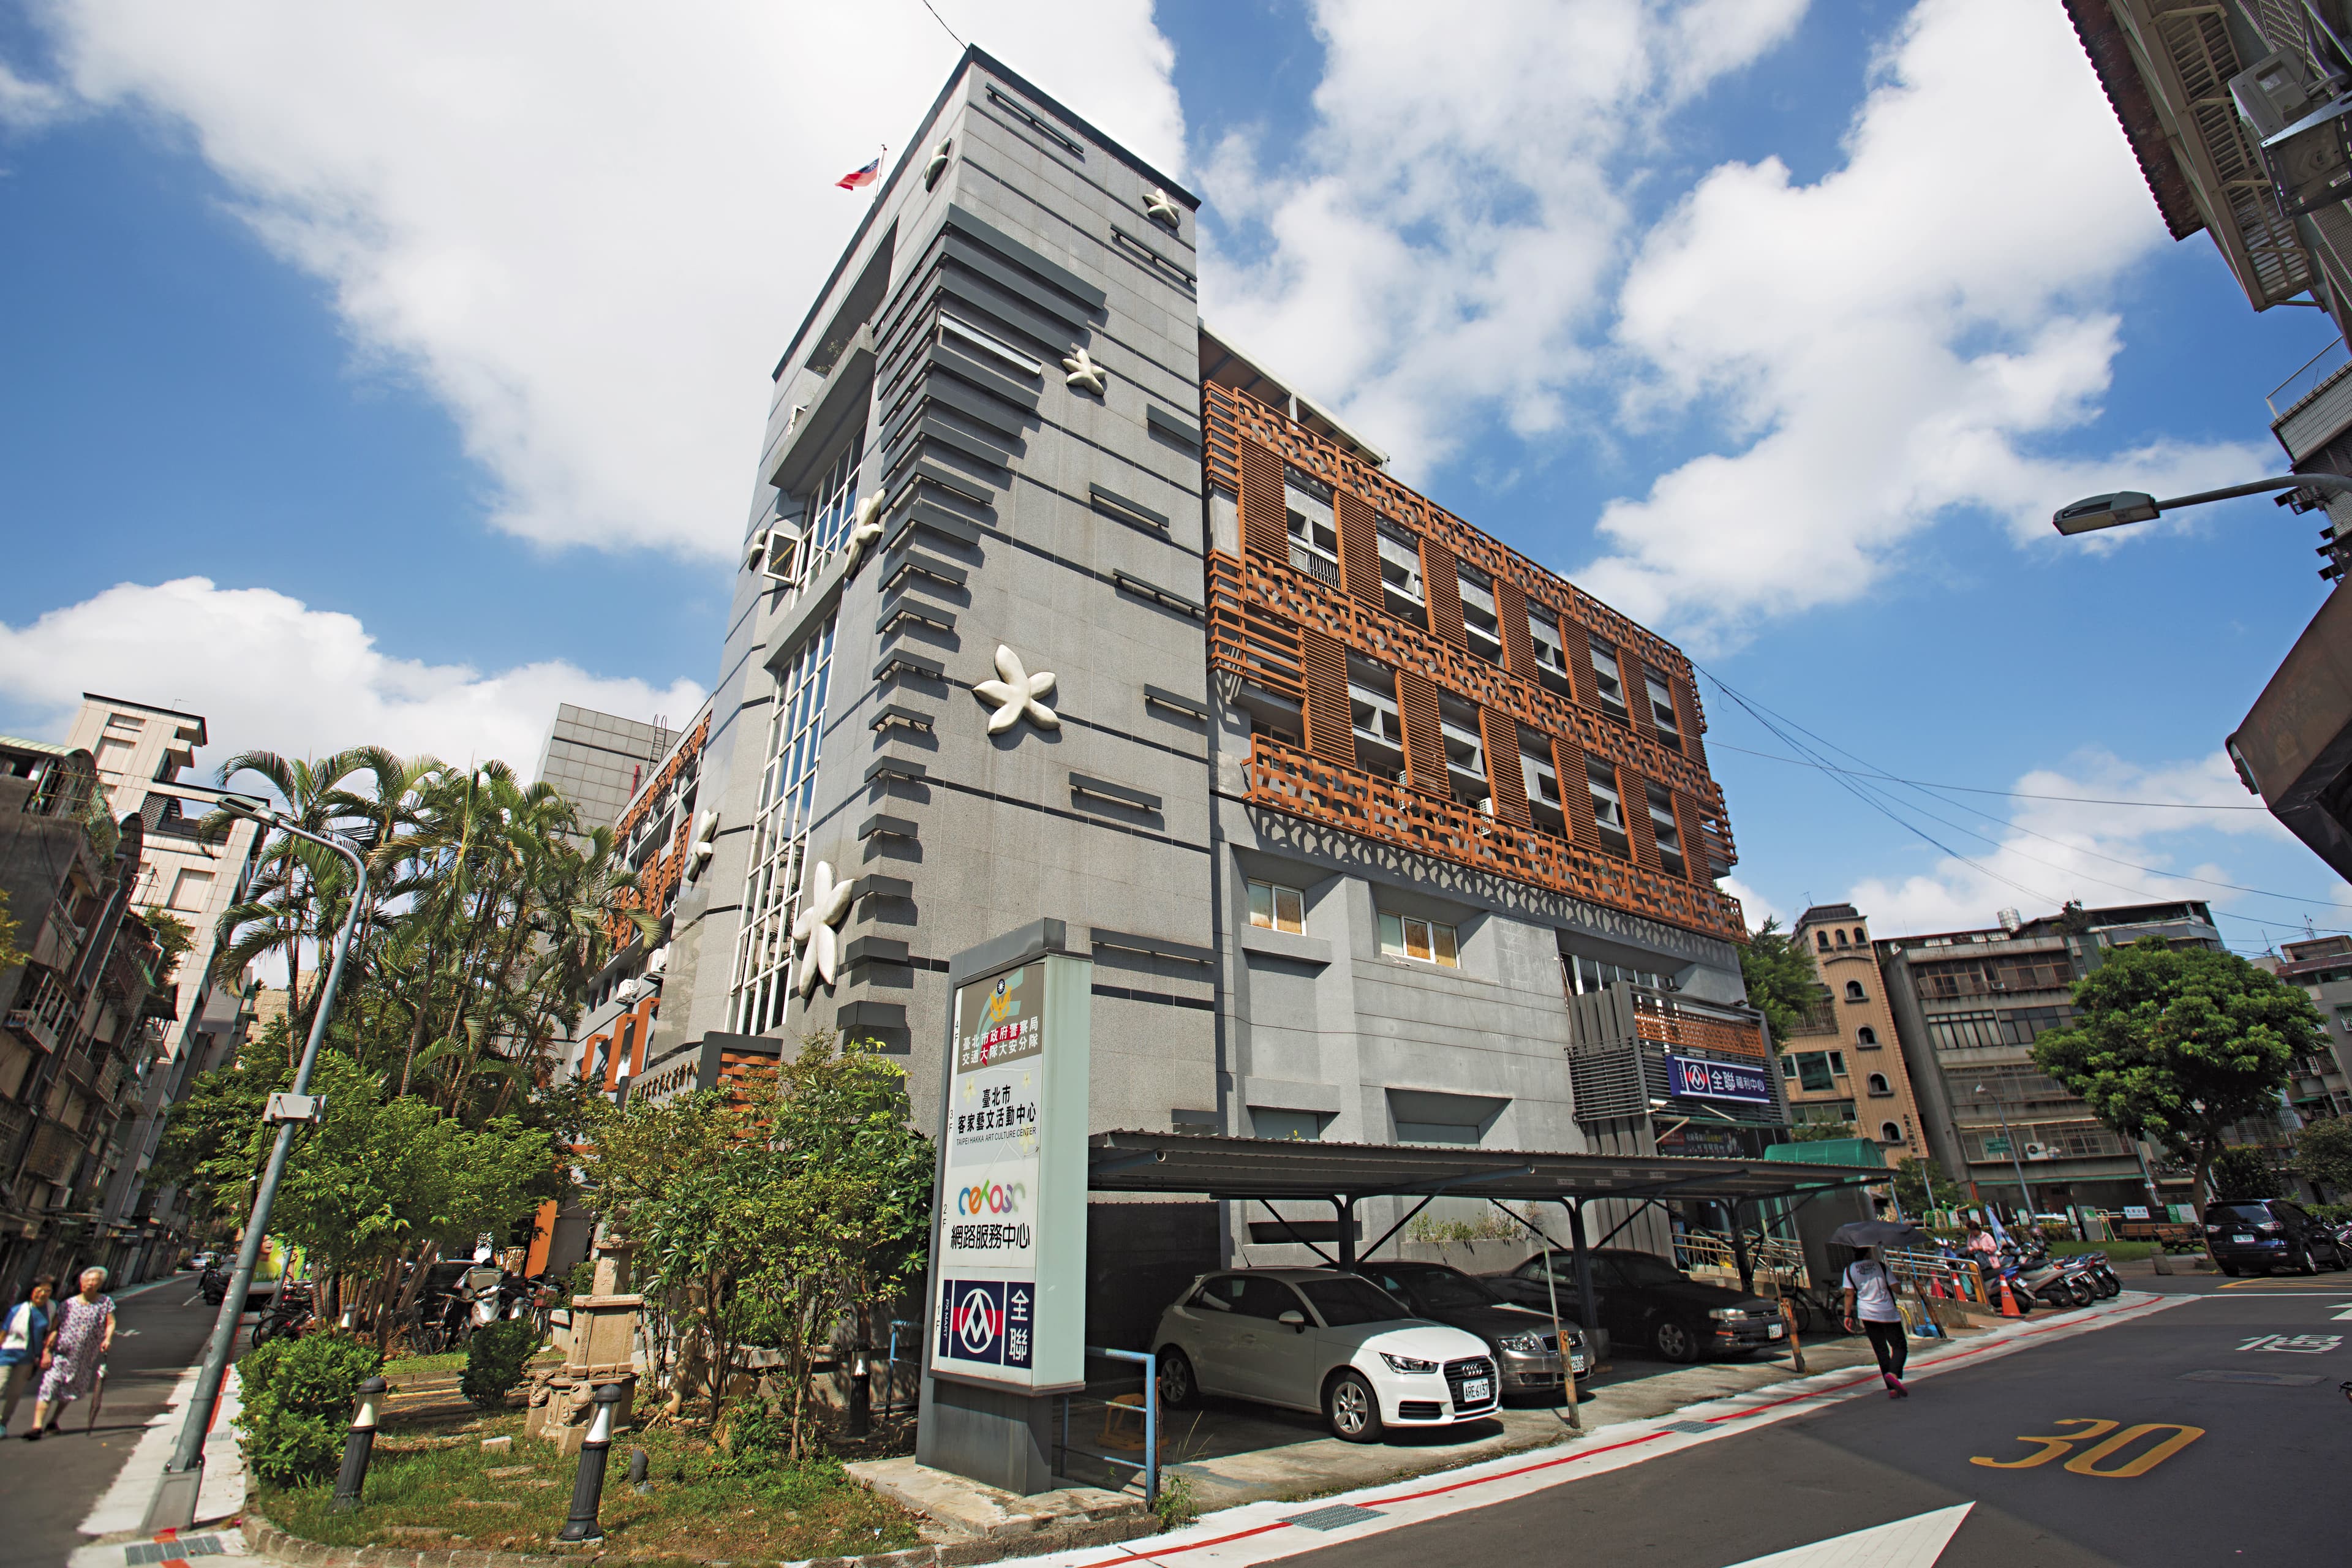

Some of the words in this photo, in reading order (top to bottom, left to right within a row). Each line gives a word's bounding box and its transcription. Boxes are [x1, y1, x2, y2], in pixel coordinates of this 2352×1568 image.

[962, 1016, 1038, 1051] 臺北市政府警察局
[962, 1034, 1038, 1066] 交通大隊大安分隊
[982, 1084, 1011, 1109] 臺北市
[958, 1102, 1036, 1134] 客家藝文活動中心
[956, 1136, 970, 1146] TAIPEI
[970, 1133, 984, 1143] HAKKA
[985, 1133, 995, 1142] ART
[995, 1129, 1016, 1140] CULTURE
[1016, 1126, 1036, 1137] CENTER
[950, 1223, 1030, 1250] 網路服務中心
[945, 1298, 950, 1311] PX
[1009, 1289, 1029, 1362] 全聯
[1970, 1417, 2206, 1477] 30
